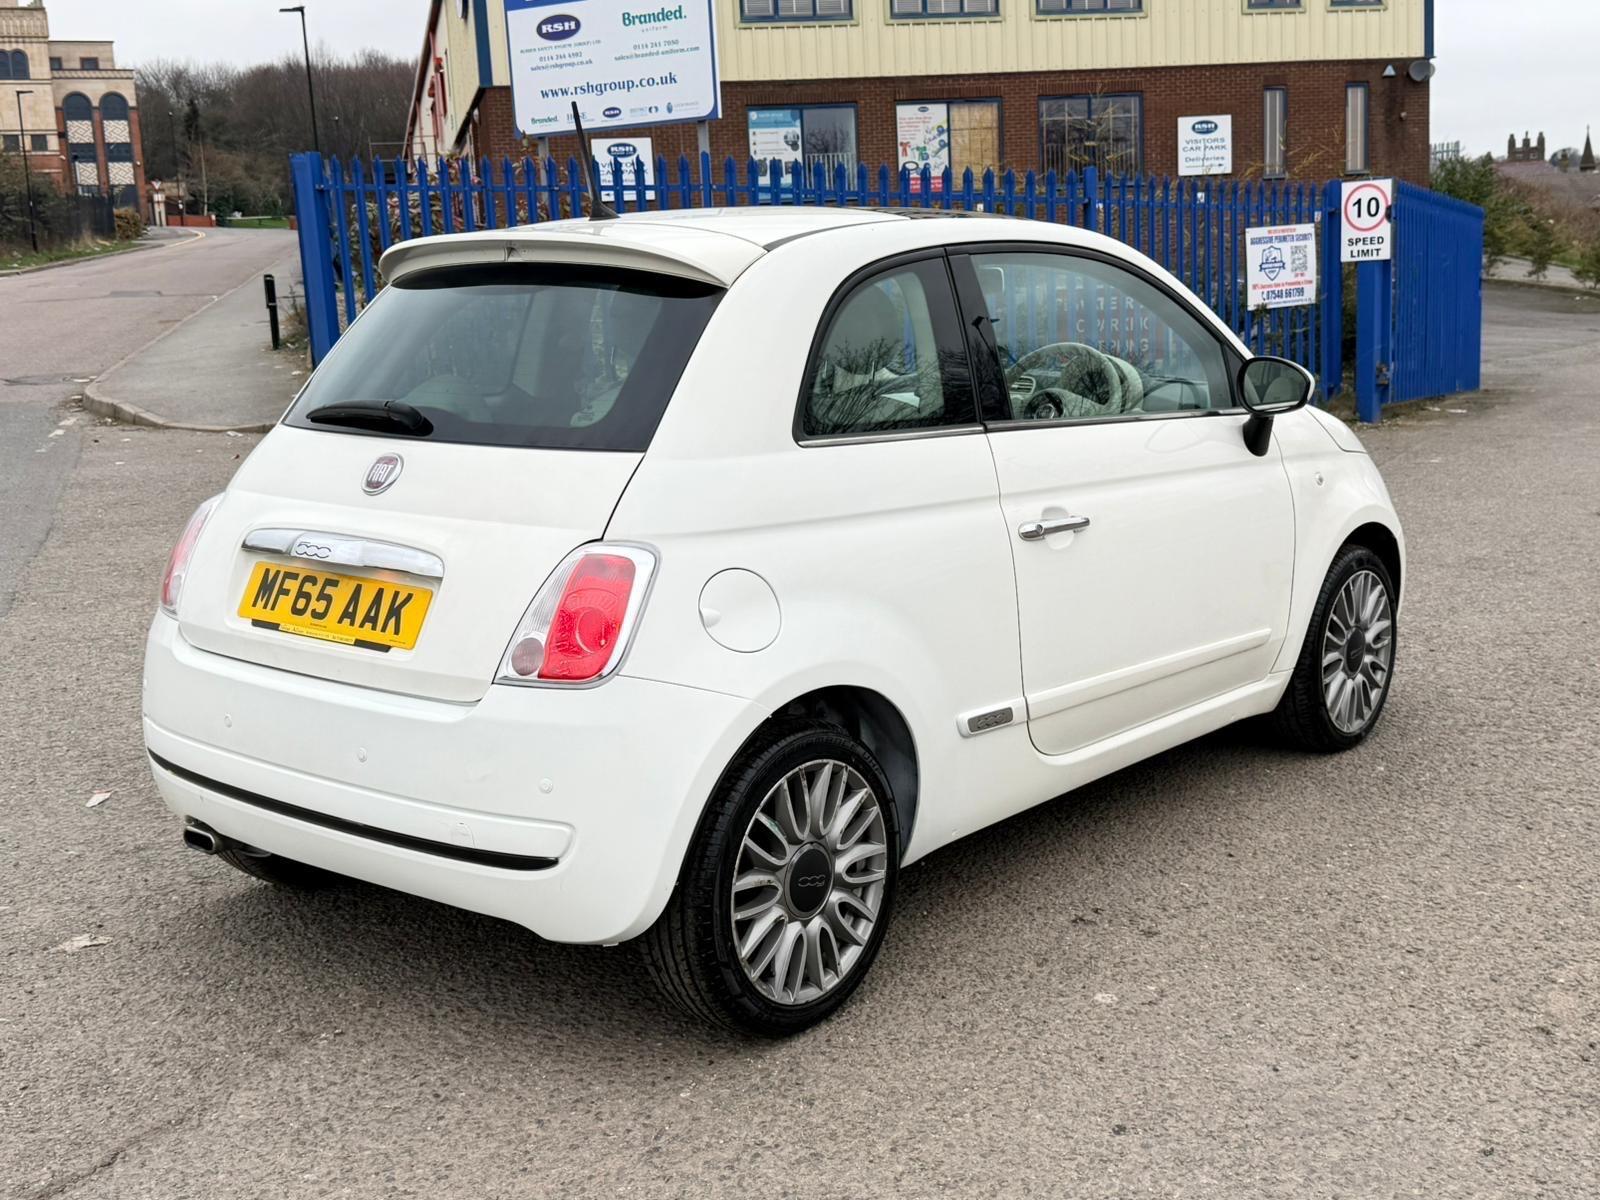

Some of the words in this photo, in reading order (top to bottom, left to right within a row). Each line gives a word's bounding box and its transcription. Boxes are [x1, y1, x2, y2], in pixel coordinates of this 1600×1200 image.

[621, 5, 687, 27] Branded.
[541, 20, 576, 33] RSH
[540, 72, 678, 100] www.rshgroup.co.uk
[1185, 137, 1225, 145] VISITORS
[1352, 197, 1380, 218] 10
[1347, 236, 1384, 247] SPEED
[1350, 248, 1382, 258] LIMIT
[367, 463, 395, 482] FIAT
[295, 541, 332, 559] 500
[252, 568, 340, 621] MF65
[337, 583, 414, 636] AAK
